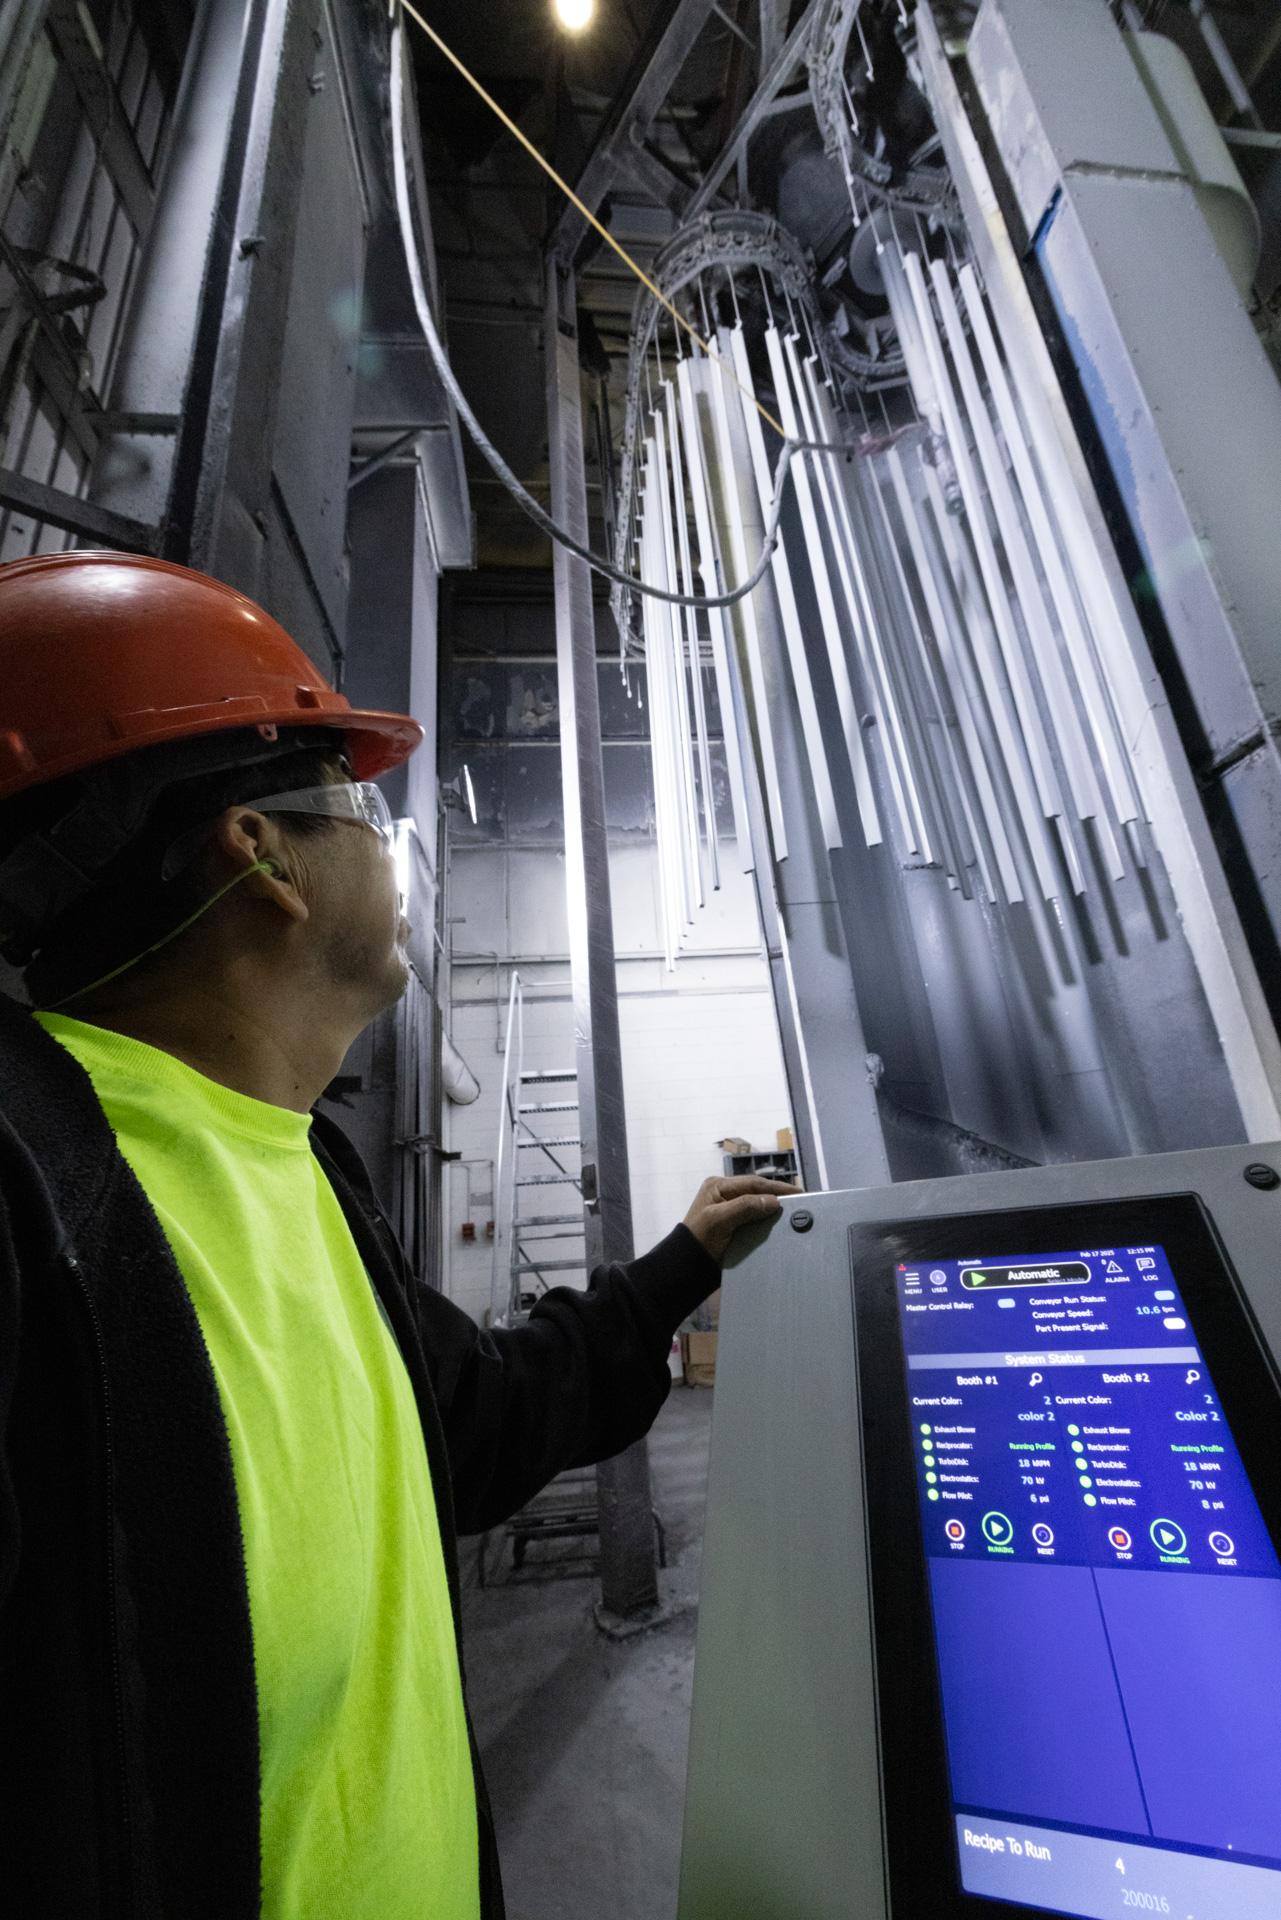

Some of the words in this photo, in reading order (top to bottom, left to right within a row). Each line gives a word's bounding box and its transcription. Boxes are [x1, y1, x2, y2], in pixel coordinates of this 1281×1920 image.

[1008, 1269, 1060, 1281] Automatic
[1029, 1298, 1062, 1306] Conveyor
[1080, 1295, 1107, 1303] Status:
[906, 1304, 927, 1312] Master
[929, 1302, 953, 1310] Control
[953, 1301, 975, 1311] Relay:
[1136, 1306, 1161, 1316] 10.6
[1032, 1311, 1066, 1320] Conveyor
[1067, 1309, 1094, 1320] Speed:
[1035, 1324, 1051, 1333] Part
[1053, 1324, 1080, 1332] Present
[1081, 1322, 1109, 1332] Signal:
[1005, 1354, 1045, 1368] System
[1048, 1353, 1086, 1364] Status
[956, 1375, 983, 1386] Booth
[985, 1375, 999, 1385] #1
[1102, 1372, 1132, 1383] Booth
[1134, 1372, 1150, 1383] #2
[912, 1397, 940, 1406] Current
[941, 1396, 963, 1406] Color:
[1043, 1396, 1052, 1406] 2
[1055, 1395, 1086, 1404] Current
[1087, 1395, 1112, 1405] Color:
[1204, 1394, 1214, 1404] 2
[1018, 1412, 1045, 1421] color
[1047, 1412, 1056, 1421] 2
[1175, 1411, 1207, 1421] Color
[1210, 1411, 1220, 1421] 2
[1009, 1443, 1035, 1451] Running
[1171, 1444, 1200, 1453] Running
[1200, 1445, 1224, 1453] Profile
[1021, 1476, 1033, 1485] 70
[1189, 1480, 1203, 1490] 70
[988, 1546, 1014, 1554] RUNNING
[1117, 1552, 1133, 1560] STOP
[1160, 1556, 1191, 1564] RUNNING
[1217, 1558, 1237, 1566] RESET
[964, 1829, 1005, 1853] Recipe
[1006, 1837, 1023, 1856] To
[1025, 1841, 1051, 1861] Run
[1115, 1857, 1126, 1875] 4
[1121, 1888, 1170, 1913] 200016
